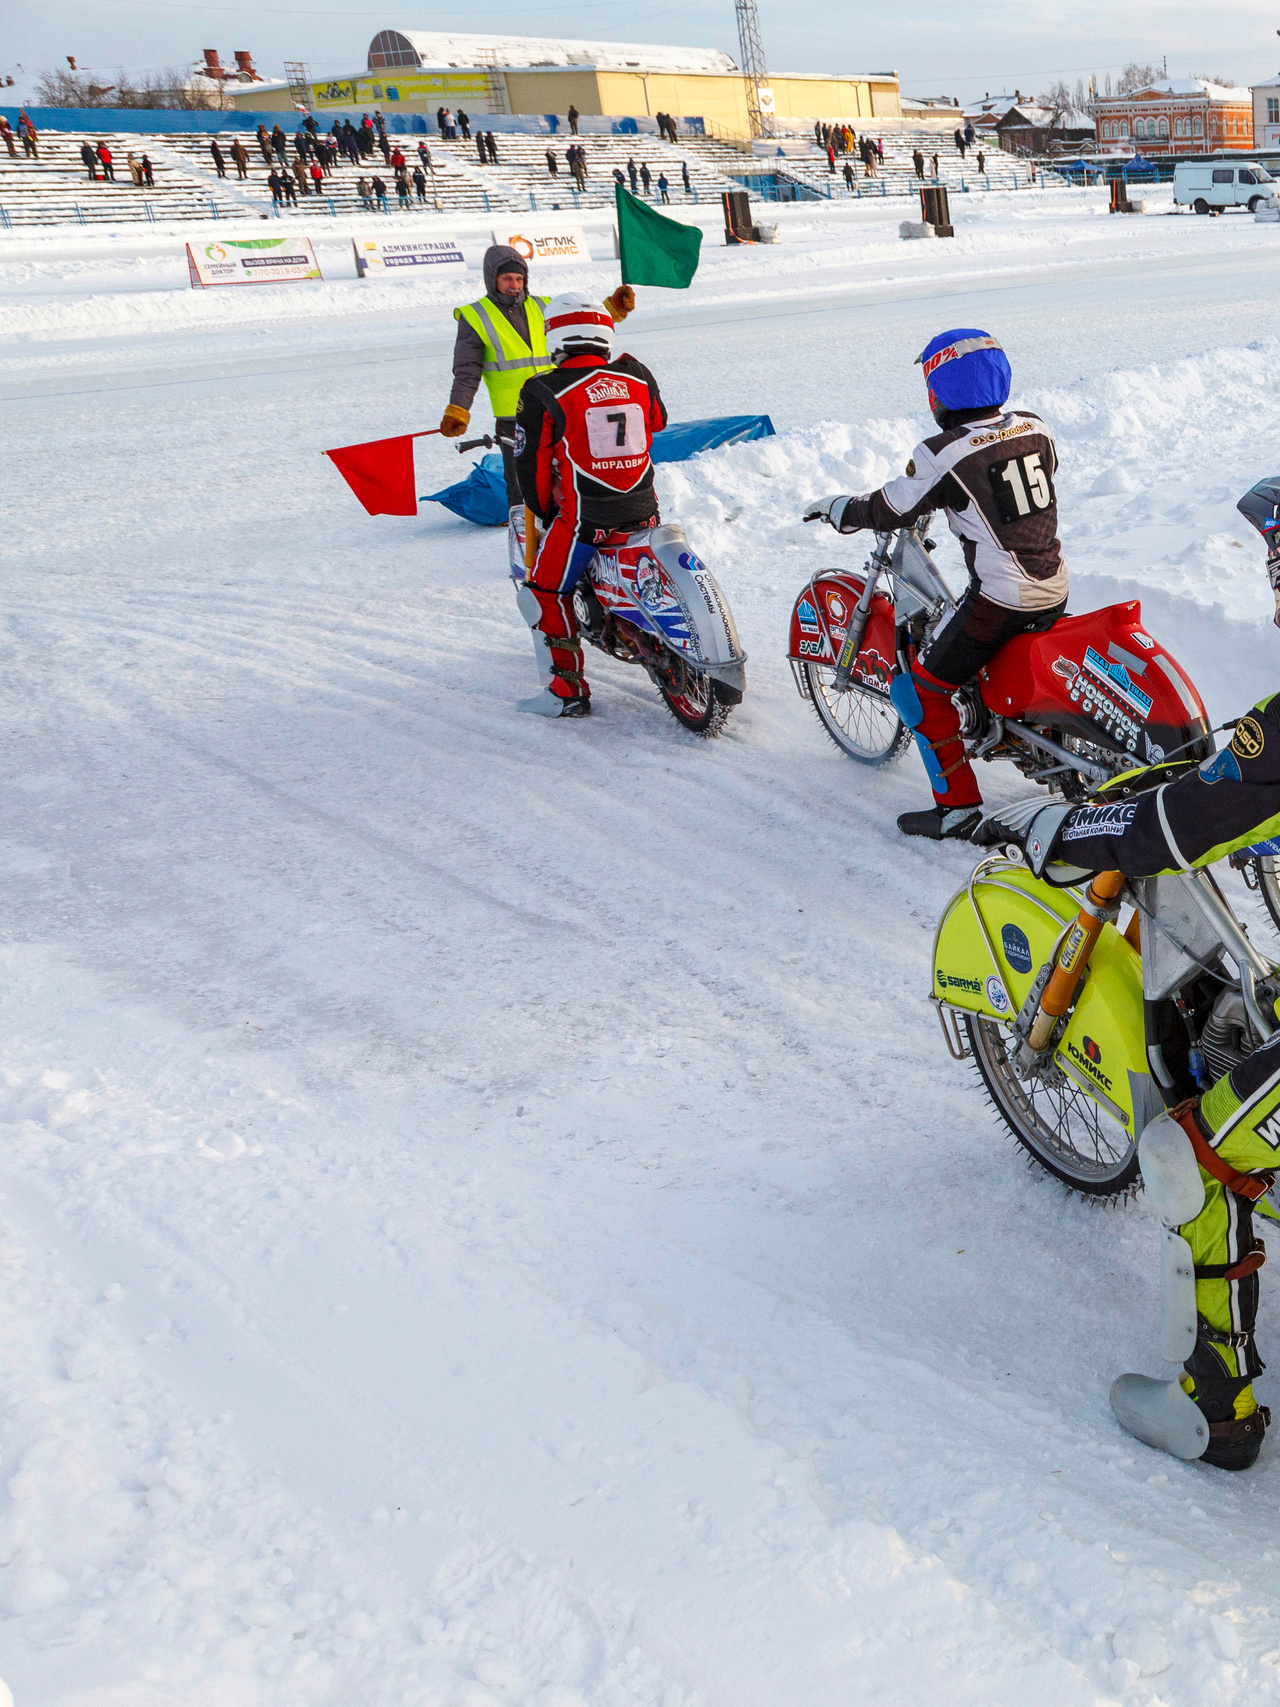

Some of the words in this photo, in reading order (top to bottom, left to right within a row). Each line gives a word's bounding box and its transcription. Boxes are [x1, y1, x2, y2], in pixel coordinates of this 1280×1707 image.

[382, 242, 456, 253] АДМИНИСТРАЦИЯ
[533, 236, 576, 247] УГМК
[537, 246, 579, 257] UMMC
[203, 262, 237, 270] СЕМЕЙНЫЙ
[385, 256, 414, 266] города
[415, 254, 460, 264] Шадринска
[606, 412, 627, 447] 7
[1001, 452, 1051, 516] 15
[694, 574, 716, 615] Системы
[1087, 648, 1109, 671] ШААЗ
[863, 675, 890, 693] ПДМ14
[1130, 683, 1152, 708] SHAAZ
[1236, 722, 1260, 754] OSO
[1003, 941, 1030, 957] БАЙКАЛ
[1067, 1041, 1113, 1092] ЮМИКС
